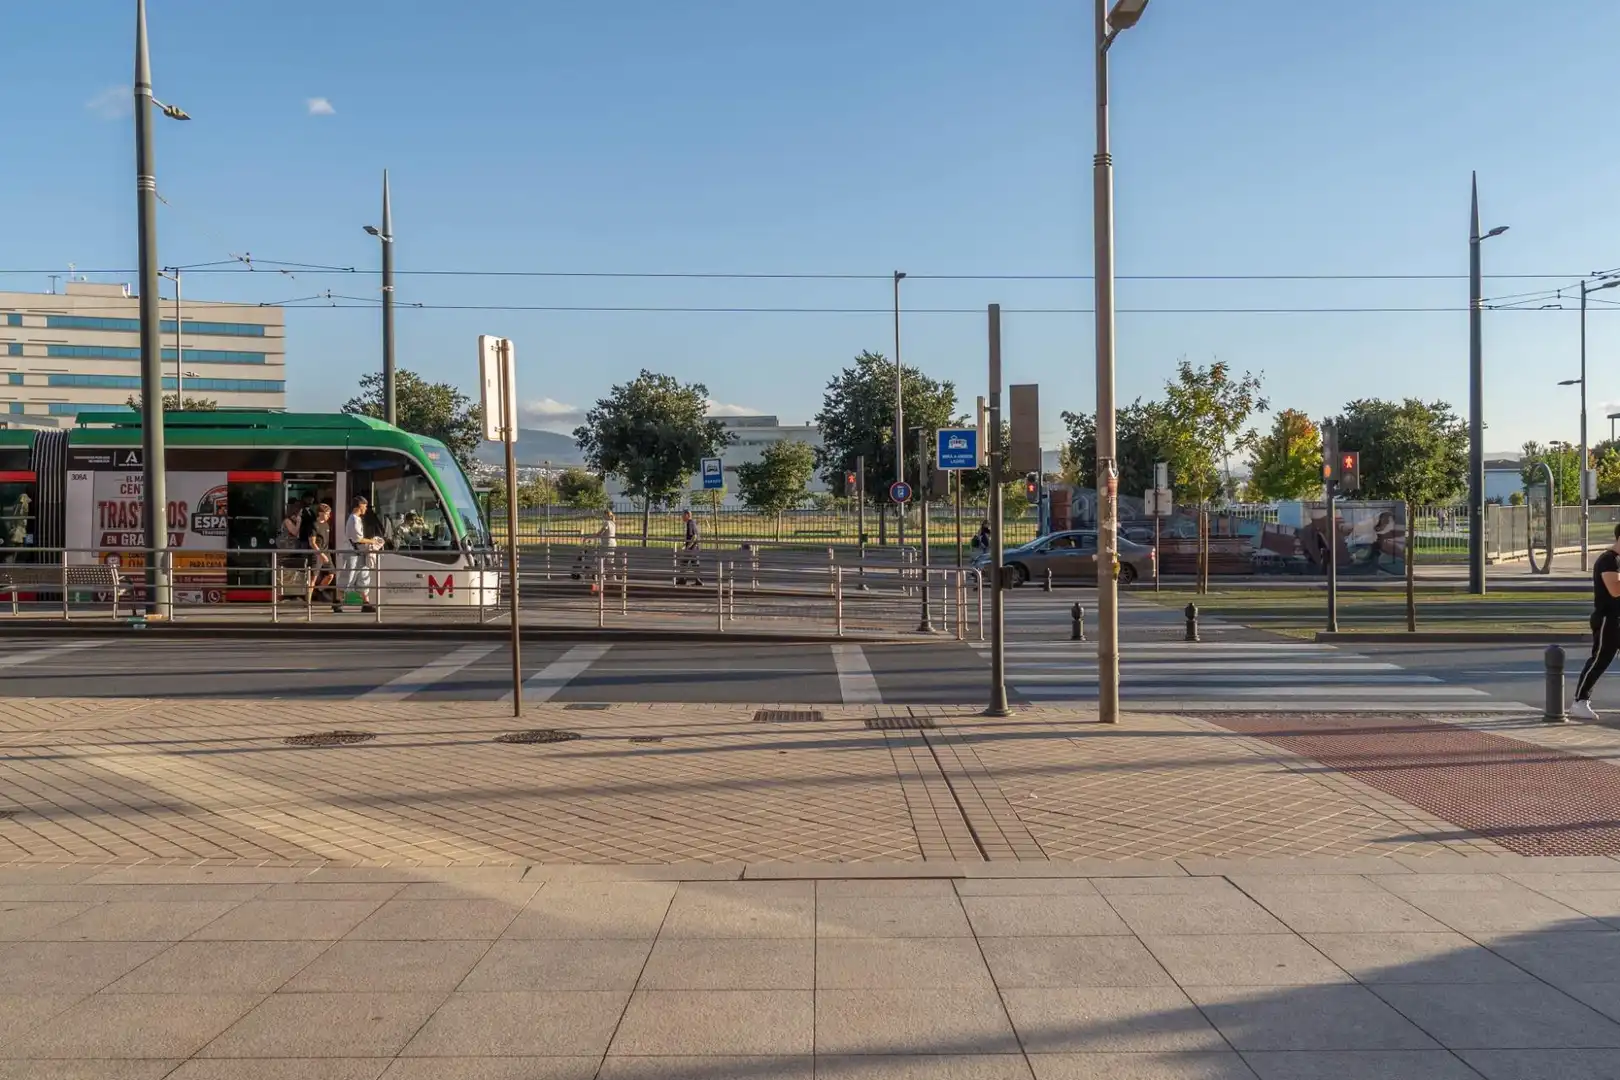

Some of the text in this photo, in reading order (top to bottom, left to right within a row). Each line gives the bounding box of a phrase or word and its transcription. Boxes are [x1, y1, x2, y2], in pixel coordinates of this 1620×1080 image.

[98, 501, 188, 529] TRASTOS
[106, 533, 178, 546] EN GRAA
